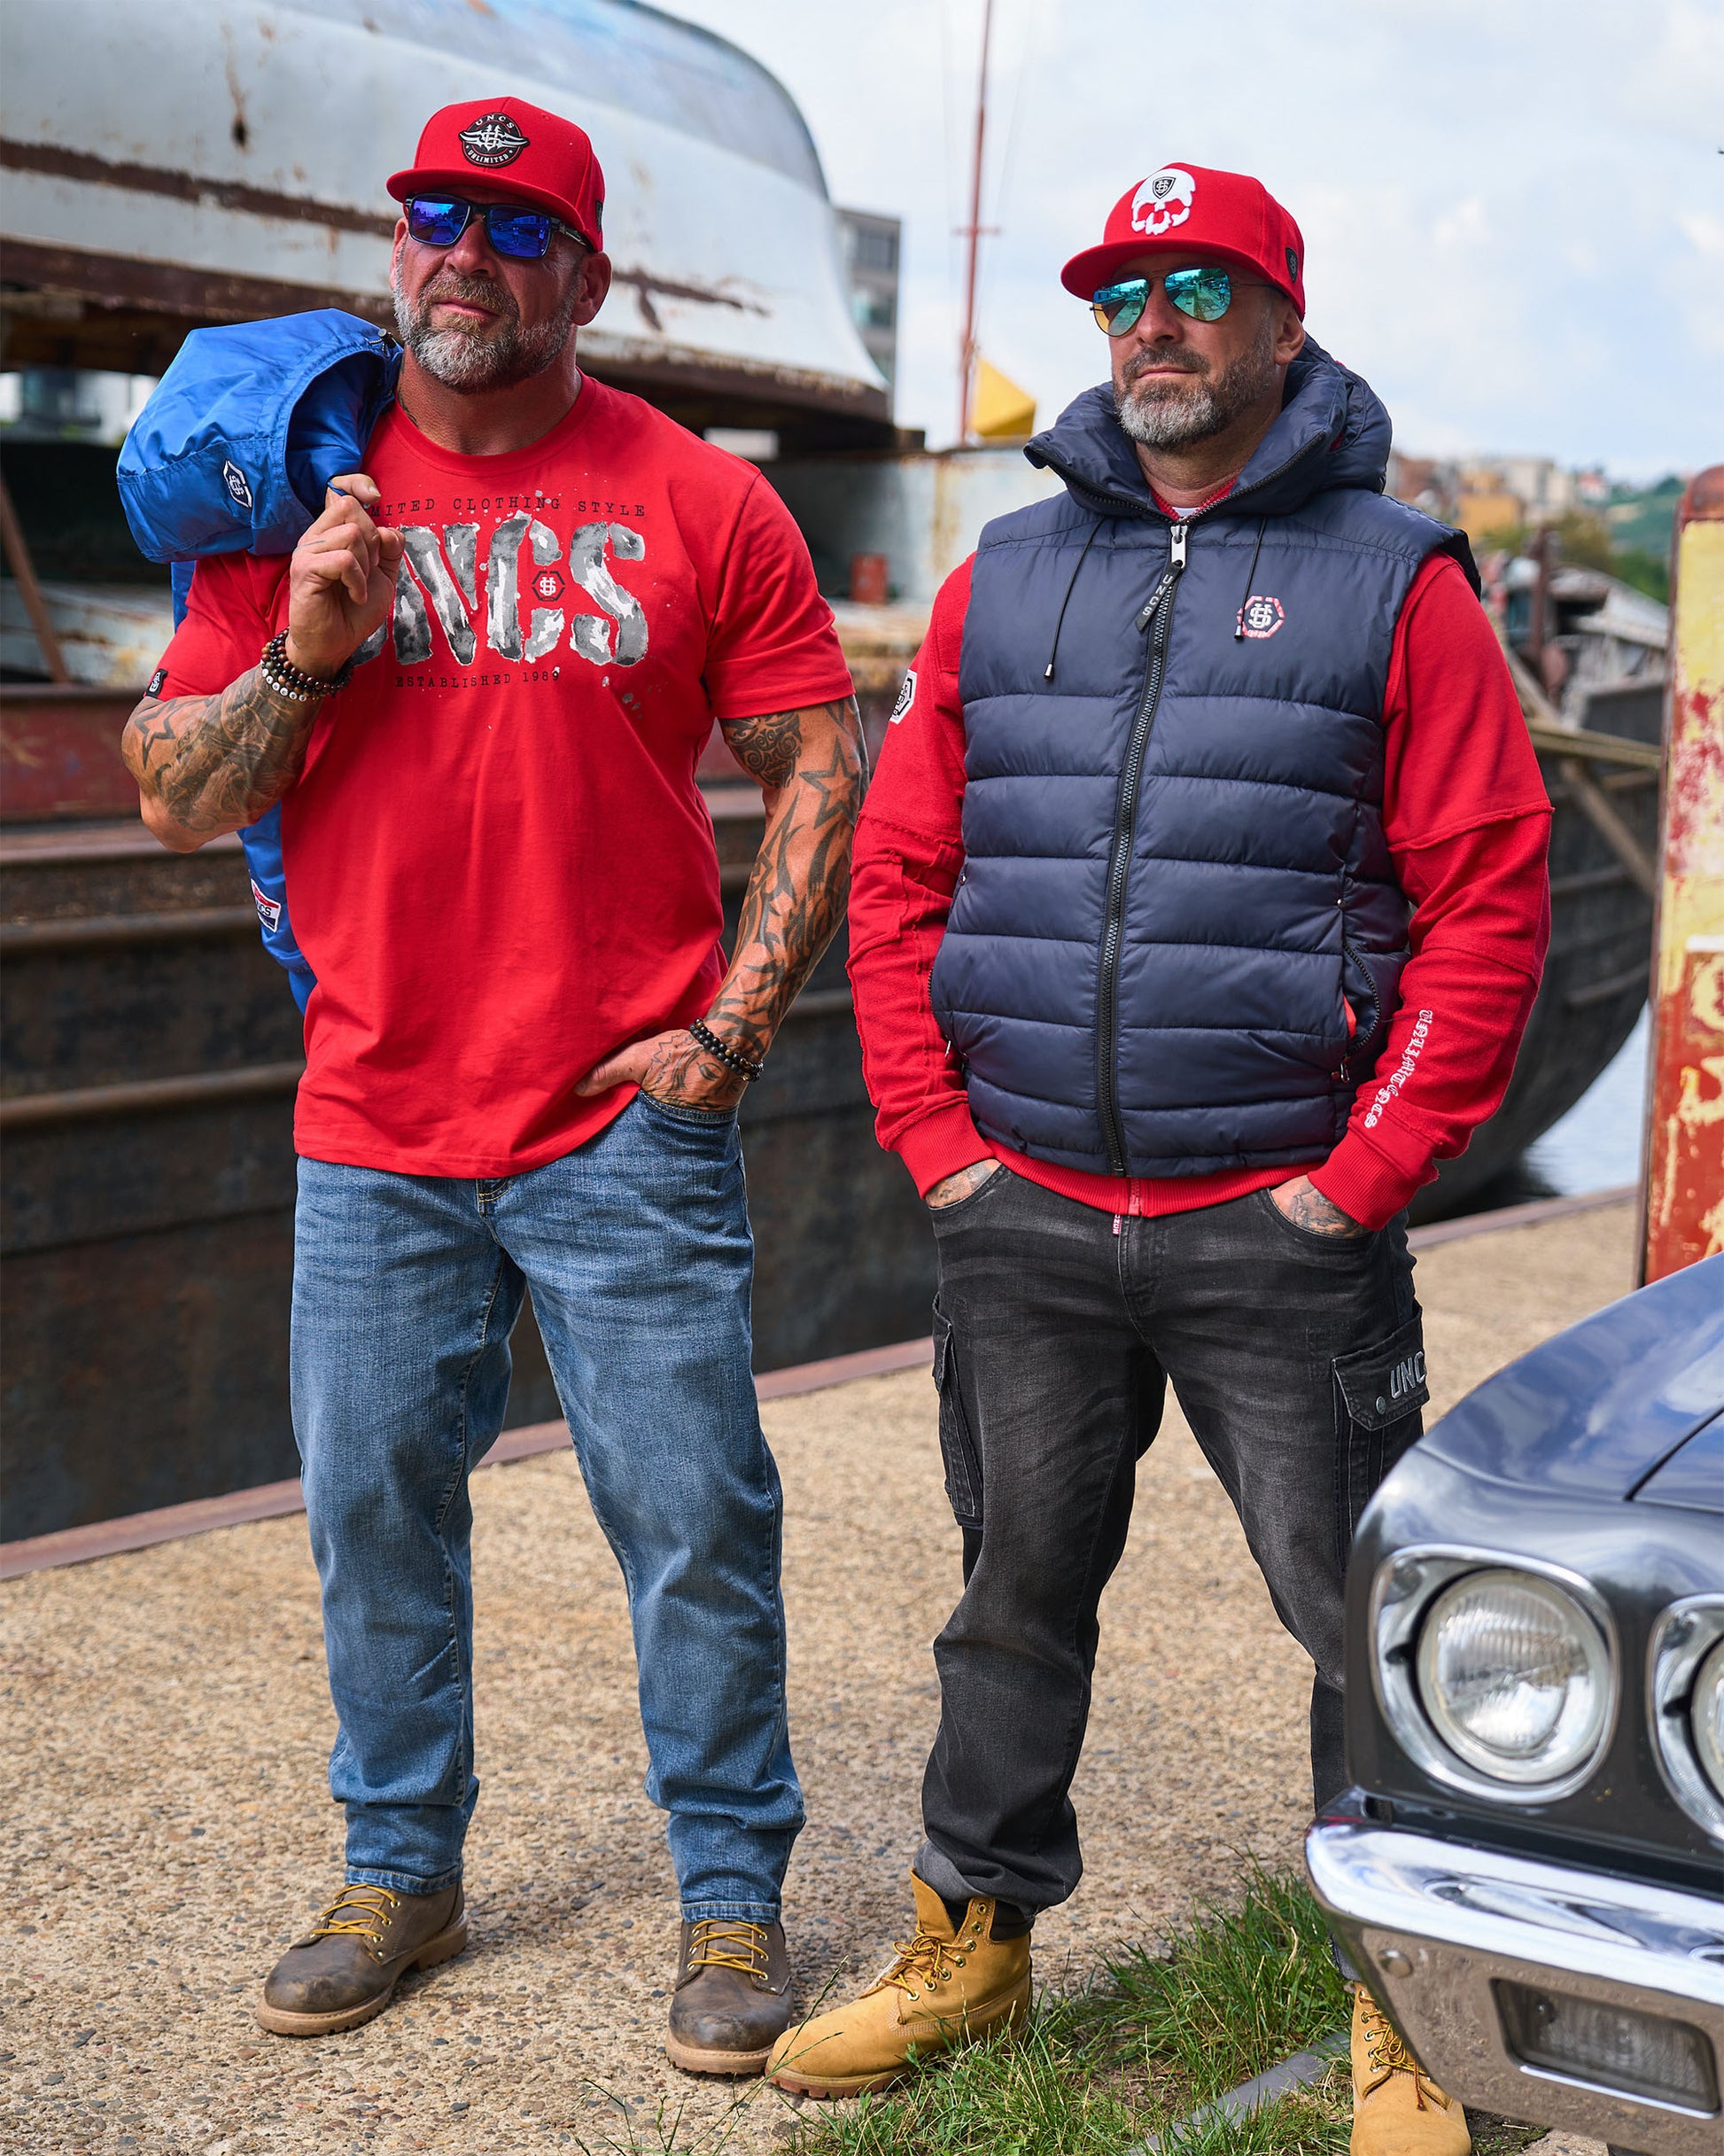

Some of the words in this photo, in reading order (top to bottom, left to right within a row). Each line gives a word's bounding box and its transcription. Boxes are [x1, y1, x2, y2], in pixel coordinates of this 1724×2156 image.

[475, 115, 514, 128] UNCS
[467, 150, 509, 163] UNLIMITED
[371, 498, 435, 517] MITED
[453, 496, 560, 510] CLOTHING
[578, 501, 645, 517] STYLE
[350, 510, 648, 666] NCS
[1142, 573, 1174, 617] UNCS
[396, 673, 511, 689] ESTABLISHED
[523, 670, 560, 683] 1989
